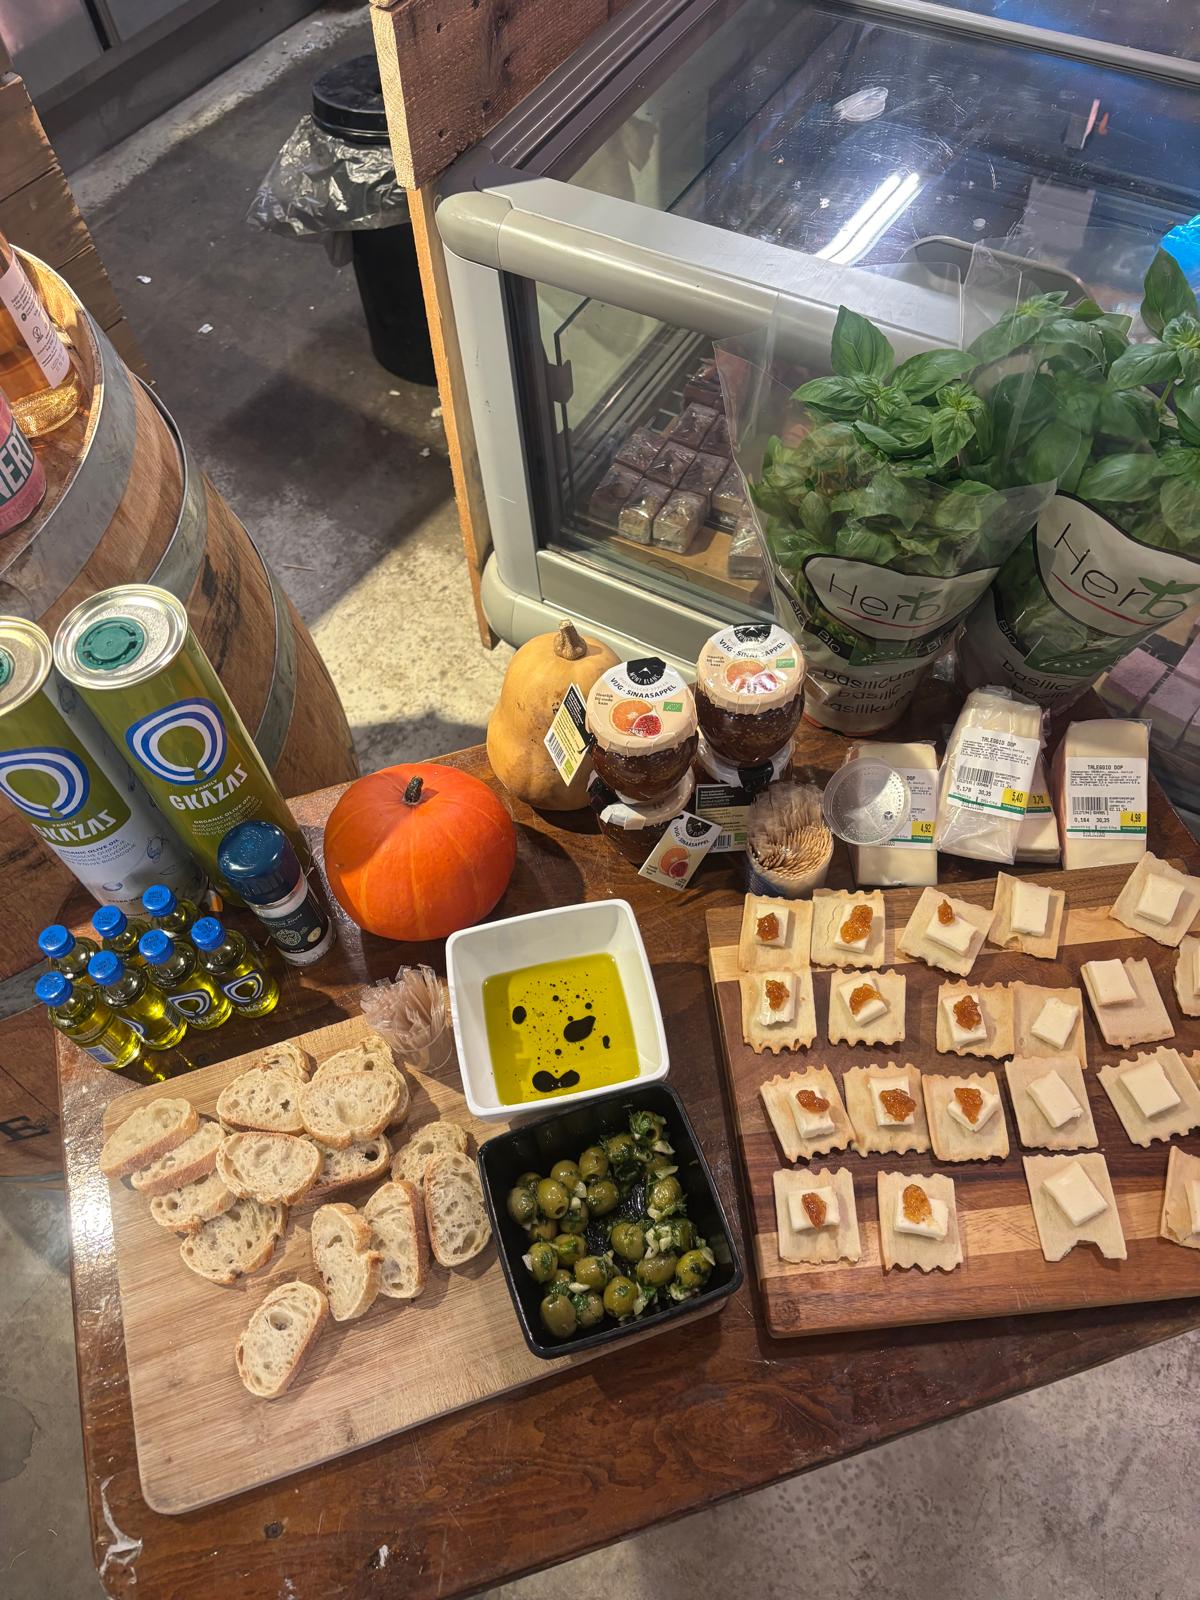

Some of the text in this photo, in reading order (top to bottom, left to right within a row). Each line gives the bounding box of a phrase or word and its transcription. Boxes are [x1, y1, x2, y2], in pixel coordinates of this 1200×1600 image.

[1053, 522, 1189, 619] Herb
[828, 572, 942, 622] Herb
[719, 638, 734, 652] VIJG
[610, 677, 624, 691] VIJG
[625, 684, 677, 699] SINAASAPPEL
[1011, 791, 1024, 804] 5,40
[920, 823, 932, 834] 4,92
